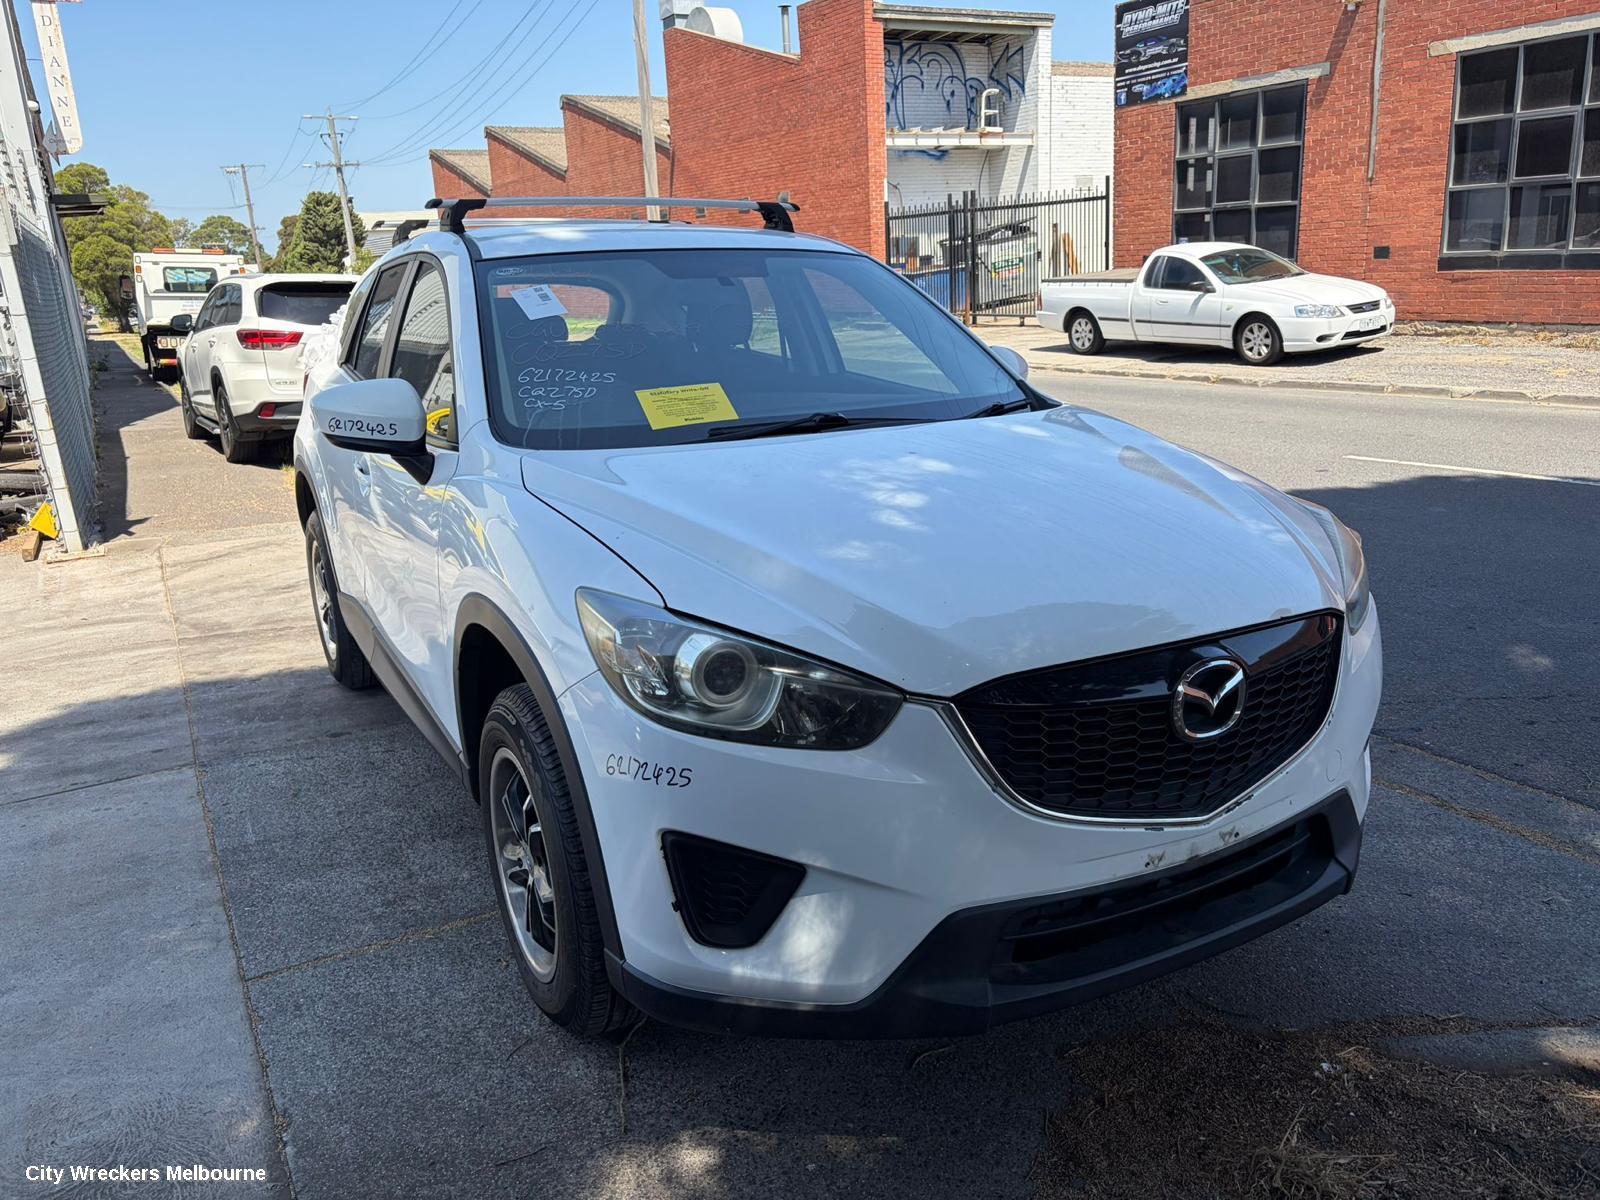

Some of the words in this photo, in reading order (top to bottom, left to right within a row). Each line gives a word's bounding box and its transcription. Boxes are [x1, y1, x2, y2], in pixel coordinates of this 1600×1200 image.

[1121, 1, 1186, 27] DYNO-MITE
[1125, 14, 1180, 32] PERFORMANCE
[41, 15, 72, 127] DIANNE
[518, 367, 616, 383] 62172425
[524, 398, 567, 410] CX-5
[328, 416, 398, 436] 62172425
[606, 753, 693, 788] 62172425
